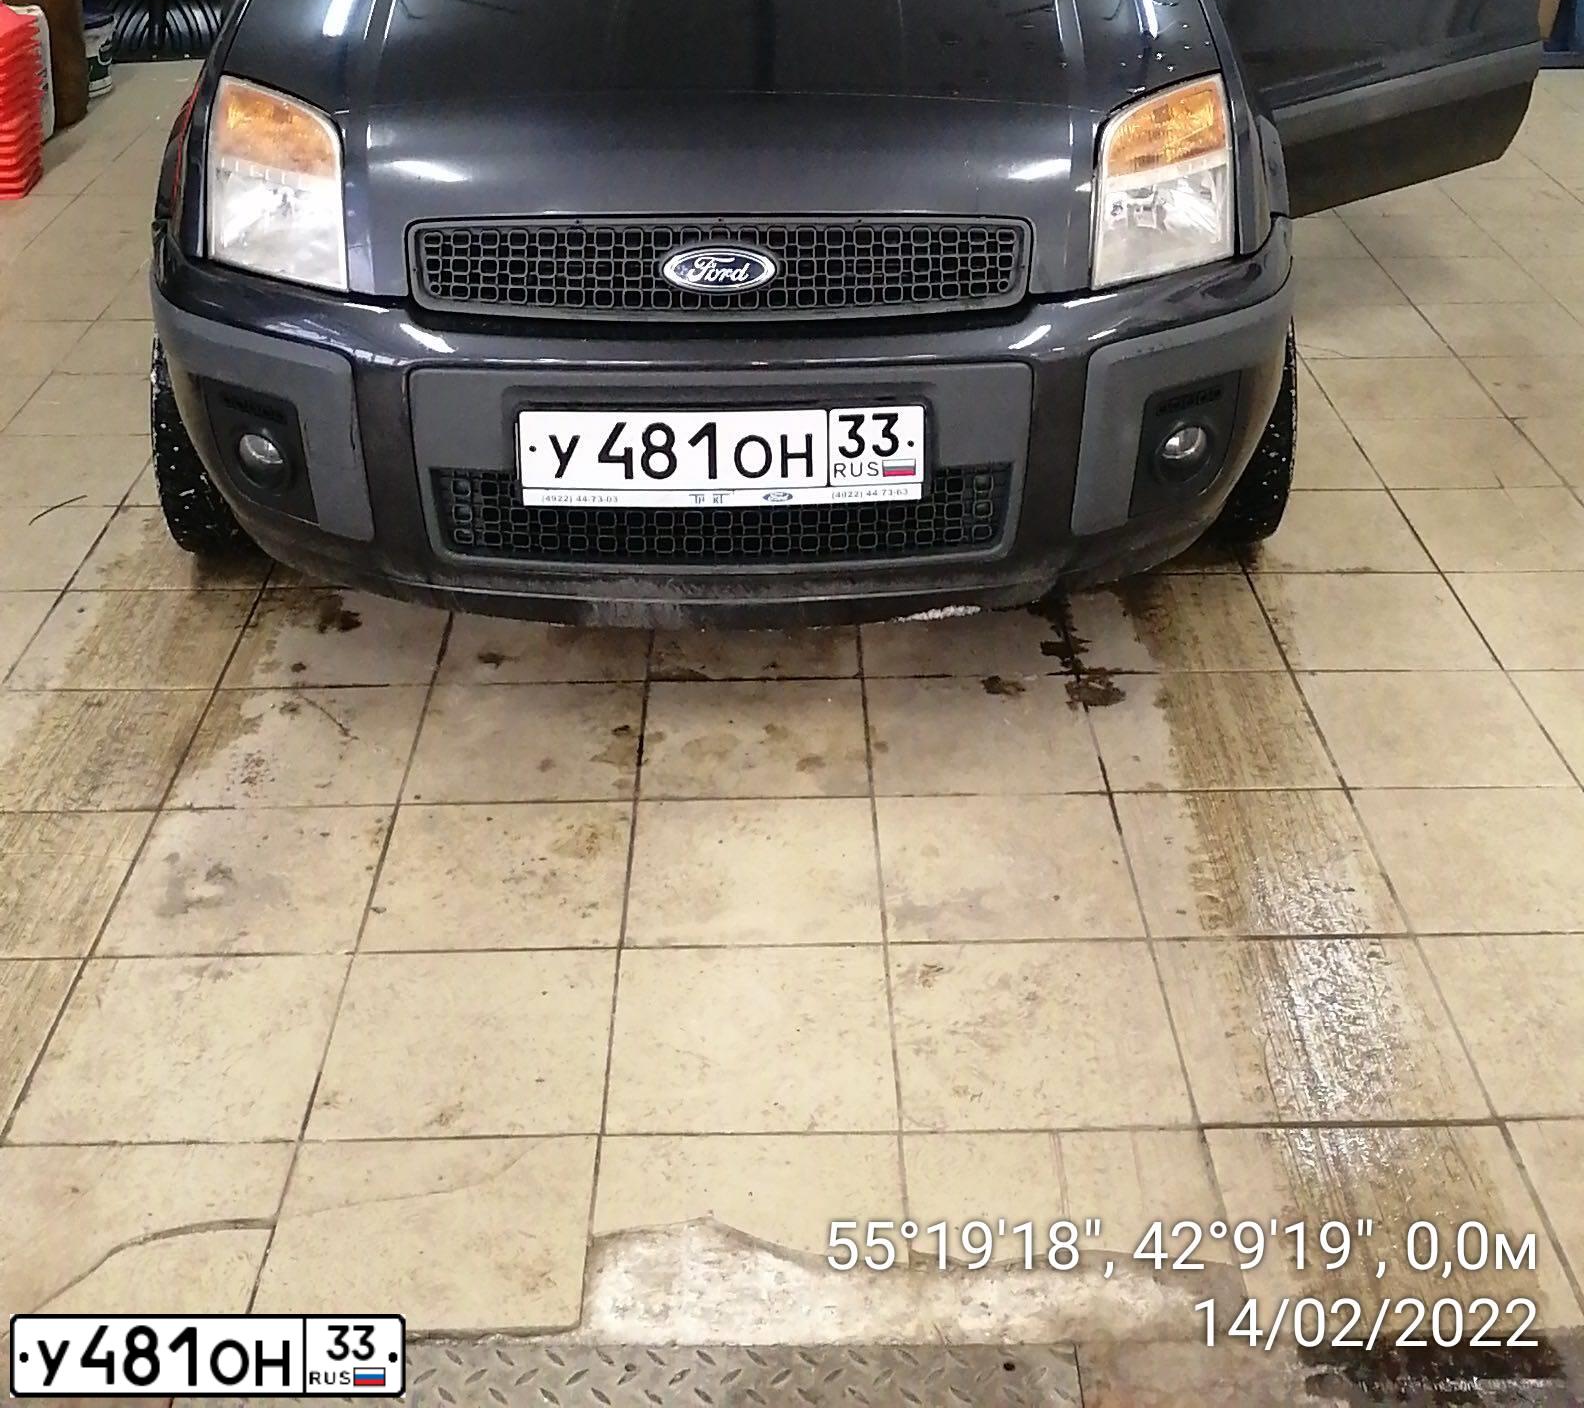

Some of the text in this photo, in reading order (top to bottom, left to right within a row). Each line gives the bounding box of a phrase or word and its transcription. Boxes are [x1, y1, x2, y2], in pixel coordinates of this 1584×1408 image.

[687, 256, 751, 282] Ford
[838, 412, 900, 459] 33
[833, 461, 879, 478] RUS
